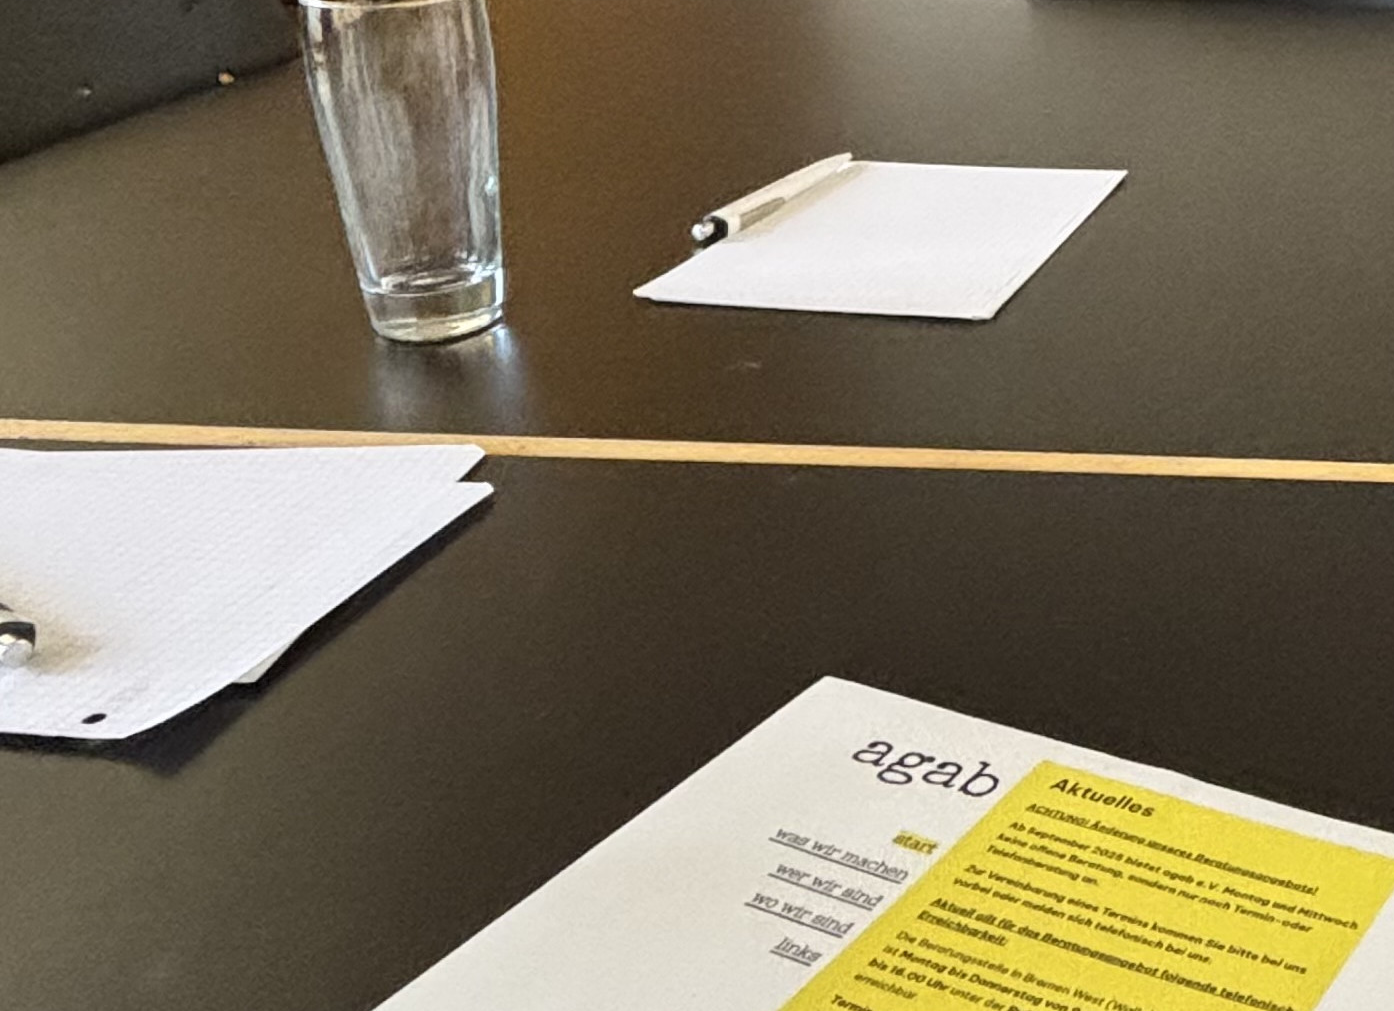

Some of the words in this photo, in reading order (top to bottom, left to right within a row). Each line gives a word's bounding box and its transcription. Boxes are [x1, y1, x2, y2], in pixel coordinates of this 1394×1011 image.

[852, 741, 1000, 797] agab
[1050, 779, 1155, 817] Aktuelles
[776, 829, 812, 847] was
[811, 842, 841, 857] wir
[842, 851, 909, 881] machen
[892, 832, 939, 855] start
[986, 844, 1080, 880] Telefonberatung
[996, 833, 1028, 847] keine
[1029, 844, 1067, 859] offene
[1127, 874, 1177, 894] sondern
[1177, 890, 1199, 901] nur
[776, 864, 810, 881] wer
[812, 876, 842, 892] wir
[841, 884, 884, 908] sind
[1009, 822, 1026, 832] Ab
[1027, 827, 1091, 851] September
[1124, 856, 1161, 873] bietet
[1162, 870, 1194, 884] agab
[1222, 886, 1270, 906] Montag
[1272, 901, 1297, 913] und
[1297, 907, 1358, 930] Mittwoch
[752, 892, 780, 908] wo
[781, 902, 812, 919] wir
[811, 914, 854, 937] sind
[953, 877, 993, 895] vorbei
[992, 891, 1021, 904] oder
[1021, 900, 1066, 919] melden
[1066, 914, 1093, 927] sich
[1094, 922, 1164, 949] telefonisch
[1164, 943, 1188, 955] bei
[964, 864, 986, 876] Zur
[988, 870, 1066, 903] Vereinbarung
[1067, 898, 1099, 912] eines
[1102, 907, 1149, 928] Termins
[1150, 922, 1203, 944] kommen
[1205, 939, 1226, 950] Sie
[1226, 945, 1259, 961] bitte
[1260, 954, 1284, 967] bei
[1284, 963, 1307, 974] uns
[1014, 926, 1041, 939] das
[776, 937, 824, 964] links
[896, 931, 917, 944] Die
[917, 937, 1010, 975] Beratungsstelle
[1022, 972, 1070, 995] Bremen
[1073, 988, 1105, 1006] West
[868, 957, 888, 971] bis
[926, 978, 950, 991] Uhr
[949, 987, 984, 1004] unter
[984, 998, 1005, 1011] der
[882, 945, 900, 956] ist
[898, 950, 948, 973] Montag
[948, 966, 968, 979] bis
[968, 973, 1044, 1006] Donnerstag
[1045, 1000, 1069, 1011] von
